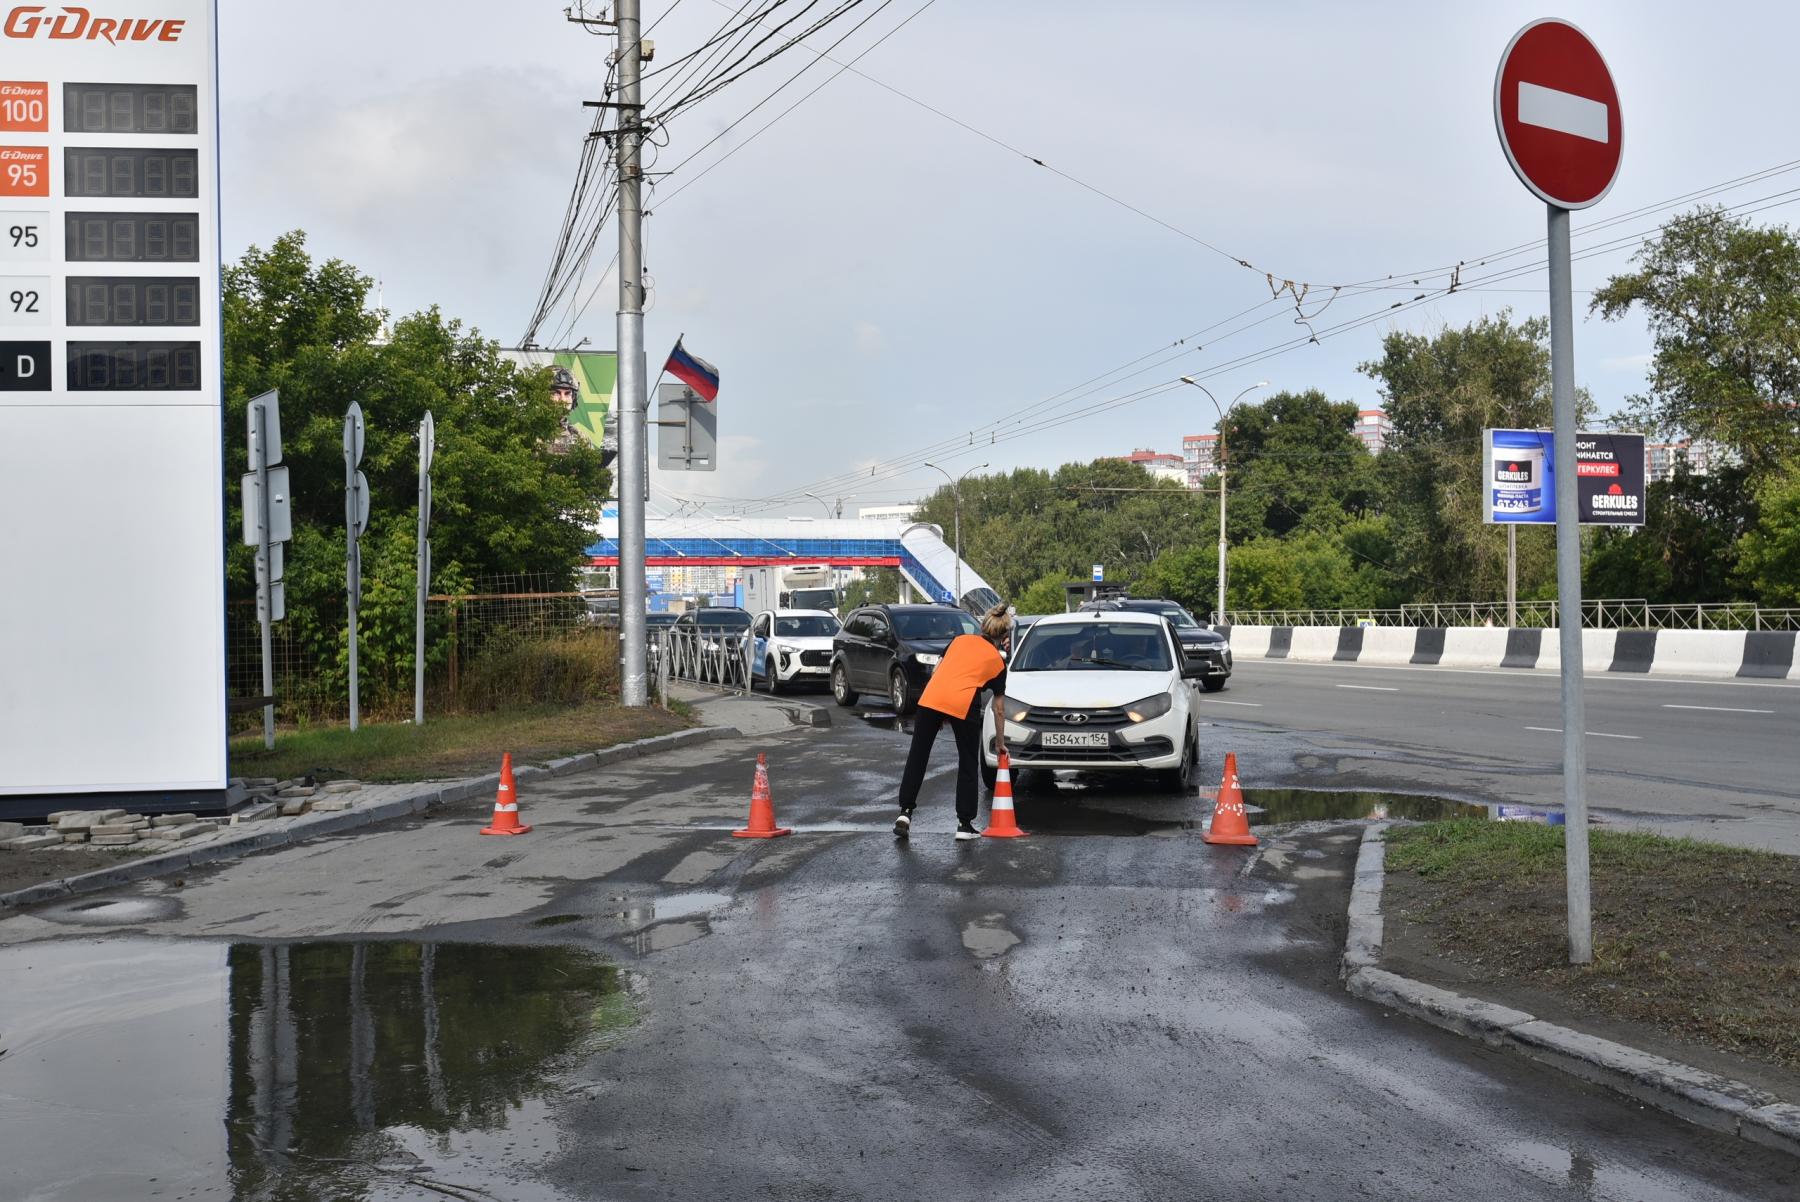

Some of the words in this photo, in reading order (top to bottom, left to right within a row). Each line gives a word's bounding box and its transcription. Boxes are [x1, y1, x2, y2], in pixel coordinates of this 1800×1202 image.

[2, 99, 43, 122] 100
[7, 164, 37, 187] 95
[9, 226, 39, 248] 95
[10, 290, 39, 313] 92
[17, 354, 35, 378] D
[1498, 471, 1529, 481] GERKULES
[1577, 465, 1615, 474] ГЕРКУЛЕС
[1592, 495, 1638, 509] GERKULES
[1090, 733, 1106, 742] 154
